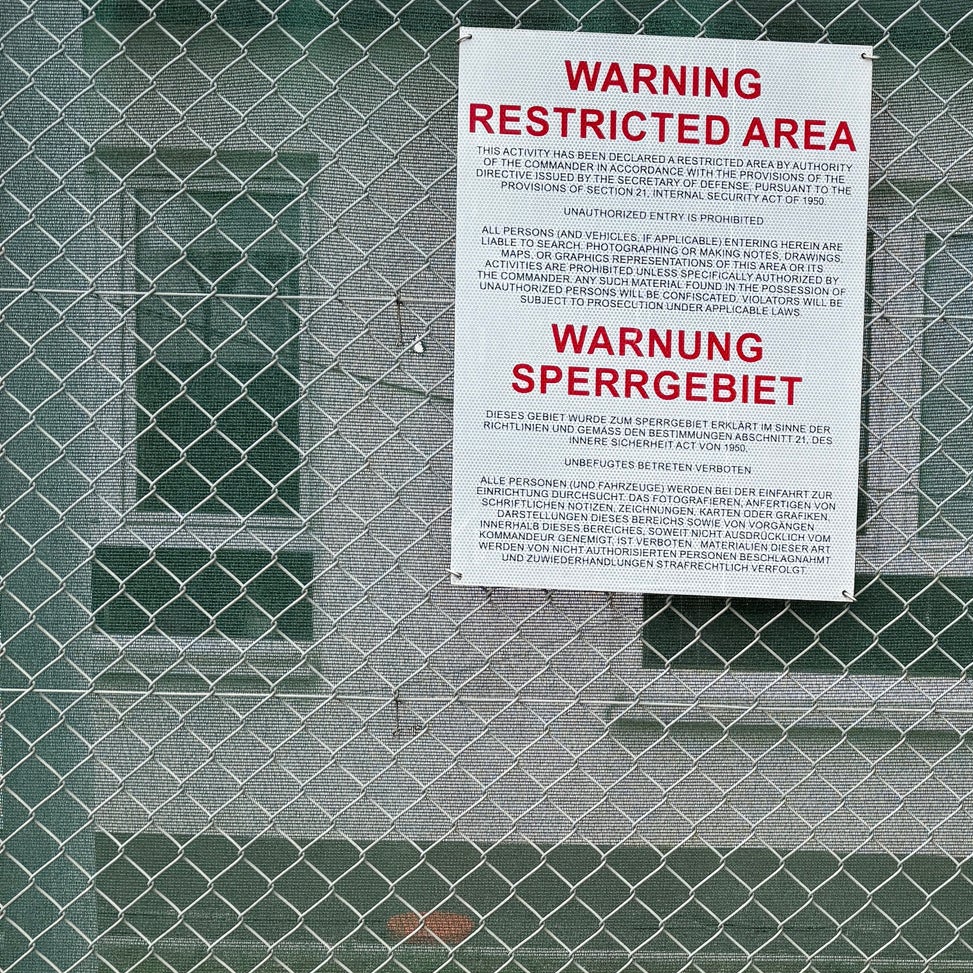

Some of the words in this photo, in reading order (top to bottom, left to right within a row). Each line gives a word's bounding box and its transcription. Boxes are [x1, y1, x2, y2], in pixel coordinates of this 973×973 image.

[564, 60, 761, 100] WARNING
[469, 103, 730, 146] RESTRICTED
[742, 117, 856, 152] AREA
[476, 146, 500, 154] THIS
[502, 147, 550, 157] ACTIVITY
[552, 150, 575, 158] HAS
[576, 151, 606, 160] BEEN
[608, 152, 666, 163] DECLARED
[676, 156, 743, 167] RESTRICTED
[745, 159, 774, 168] AREA
[776, 161, 790, 169] BY
[792, 161, 852, 171] AUTHORITY
[483, 157, 497, 166] OF
[500, 158, 521, 167] THE
[524, 160, 593, 170] COMMANDER
[609, 164, 684, 175] ACCORDANCE
[686, 168, 713, 176] WITH
[715, 169, 737, 178] THE
[739, 171, 804, 181] PROVISIONS
[806, 173, 822, 182] OF
[824, 174, 845, 183] THE
[475, 168, 532, 179] DIRECTIVE
[535, 171, 574, 181] ISSUED
[577, 174, 591, 182] BY
[593, 174, 614, 183] THE
[617, 175, 680, 186] SECRETARY
[682, 179, 697, 187] OF
[754, 182, 812, 192] PURSUANT
[814, 185, 828, 193] TO
[830, 186, 852, 195] THE
[500, 181, 566, 192] PROVISIONS
[569, 184, 583, 193] OF
[586, 185, 633, 196] SECTION
[652, 189, 704, 199] INTERNAL
[706, 192, 759, 202] SECURITY
[761, 194, 782, 203] ACT
[784, 195, 799, 204] OF
[563, 207, 646, 219] UNAUTHORIZED
[649, 211, 685, 221] ENTRY
[700, 214, 764, 224] PROHIBITED
[481, 226, 500, 234] ALL
[503, 226, 554, 236] PERSONS
[723, 238, 778, 248] ENTERING
[780, 240, 820, 250] HEREIN
[822, 242, 843, 251] ARE
[481, 237, 517, 246] LIABLE
[519, 238, 534, 247] TO
[586, 242, 678, 254] PHOTOGRAPHING
[681, 247, 697, 255] OR
[699, 248, 740, 257] MAKING
[484, 259, 542, 269] ACTIVITIES
[544, 262, 566, 271] ARE
[569, 264, 633, 274] PROHIBITED
[635, 267, 677, 277] UNLESS
[680, 269, 754, 280] SPECIFICALLY
[755, 273, 822, 284] AUTHORIZED
[825, 276, 839, 284] BY
[536, 251, 552, 259] OR
[554, 252, 609, 262] GRAPHICS
[715, 259, 730, 268] OF
[732, 261, 756, 269] THIS
[758, 262, 787, 270] AREA
[788, 263, 805, 271] OR
[807, 264, 823, 272] ITS
[476, 270, 497, 279] THE
[598, 276, 628, 285] SUCH
[630, 278, 682, 288] MATERIAL
[685, 281, 722, 290] FOUND
[737, 283, 759, 292] THE
[761, 284, 829, 295] POSSESSION
[832, 287, 846, 295] OF
[479, 282, 562, 293] UNAUTHORIZED
[565, 286, 616, 296] PERSONS
[618, 289, 644, 298] WILL
[646, 290, 659, 298] BE
[741, 295, 799, 305] VIOLATORS
[802, 298, 826, 306] WILL
[829, 298, 843, 307] BE
[519, 295, 567, 305] SUBJECT
[569, 297, 584, 305] TO
[665, 302, 703, 311] UNDER
[704, 304, 768, 315] APPLICABLE
[551, 323, 763, 363] WARNUNG
[511, 363, 803, 406] SPERRGEBIET
[483, 421, 549, 432] RICHTLINIEN
[551, 424, 574, 433] UND
[623, 427, 645, 436] DEN
[648, 429, 732, 440] BESTIMMUNGEN
[734, 432, 792, 443] ABSCHNITT
[811, 436, 832, 444] DES
[485, 410, 524, 419] DIESES
[527, 412, 565, 421] GEBIET
[568, 414, 606, 423] WURDE
[609, 416, 632, 424] ZUM
[634, 417, 708, 428] SPERRGEBIET
[774, 423, 806, 432] SINNE
[809, 425, 830, 433] DER
[568, 436, 607, 445] INNERE
[610, 438, 673, 448] SICHERHEIT
[675, 441, 696, 449] ACT
[698, 442, 720, 450] VON
[563, 458, 635, 469] UNBEFUGTES
[637, 461, 692, 471] BETRETEN
[694, 463, 751, 474] VERBOTEN
[476, 487, 548, 497] EINRICHTUNG
[628, 493, 649, 502] DAS
[745, 498, 811, 509] ANFERTIGEN
[813, 502, 835, 510] VON
[479, 476, 506, 485] ALLE
[508, 477, 567, 487] PERSONEN
[667, 484, 712, 494] WERDEN
[734, 487, 756, 496] DER
[758, 488, 809, 498] EINFAHRT
[811, 490, 832, 499] ZUR
[481, 498, 564, 509] SCHRIFTLICHEN
[699, 508, 740, 517] KARTEN
[743, 509, 773, 518] ODER
[497, 509, 588, 521] DARSTELLUNGEN
[590, 513, 629, 523] DIESES
[686, 518, 721, 527] SOWIE
[723, 520, 745, 528] VON
[478, 530, 554, 541] KOMMANDEUR
[616, 536, 633, 544] IST
[699, 540, 768, 551] MATERIALIEN
[770, 543, 808, 552] DIESER
[810, 545, 831, 553] ART
[541, 522, 580, 532] DIESES
[690, 529, 722, 537] NICHT
[807, 534, 830, 542] VOM
[478, 541, 524, 551] WERDEN
[526, 544, 549, 552] VON
[552, 545, 584, 553] NICHT
[679, 550, 737, 560] PERSONEN
[739, 552, 831, 564] BESCHLAGNAHMT
[501, 553, 524, 561] UND
[656, 560, 748, 572] STRAFRECHTLICH
